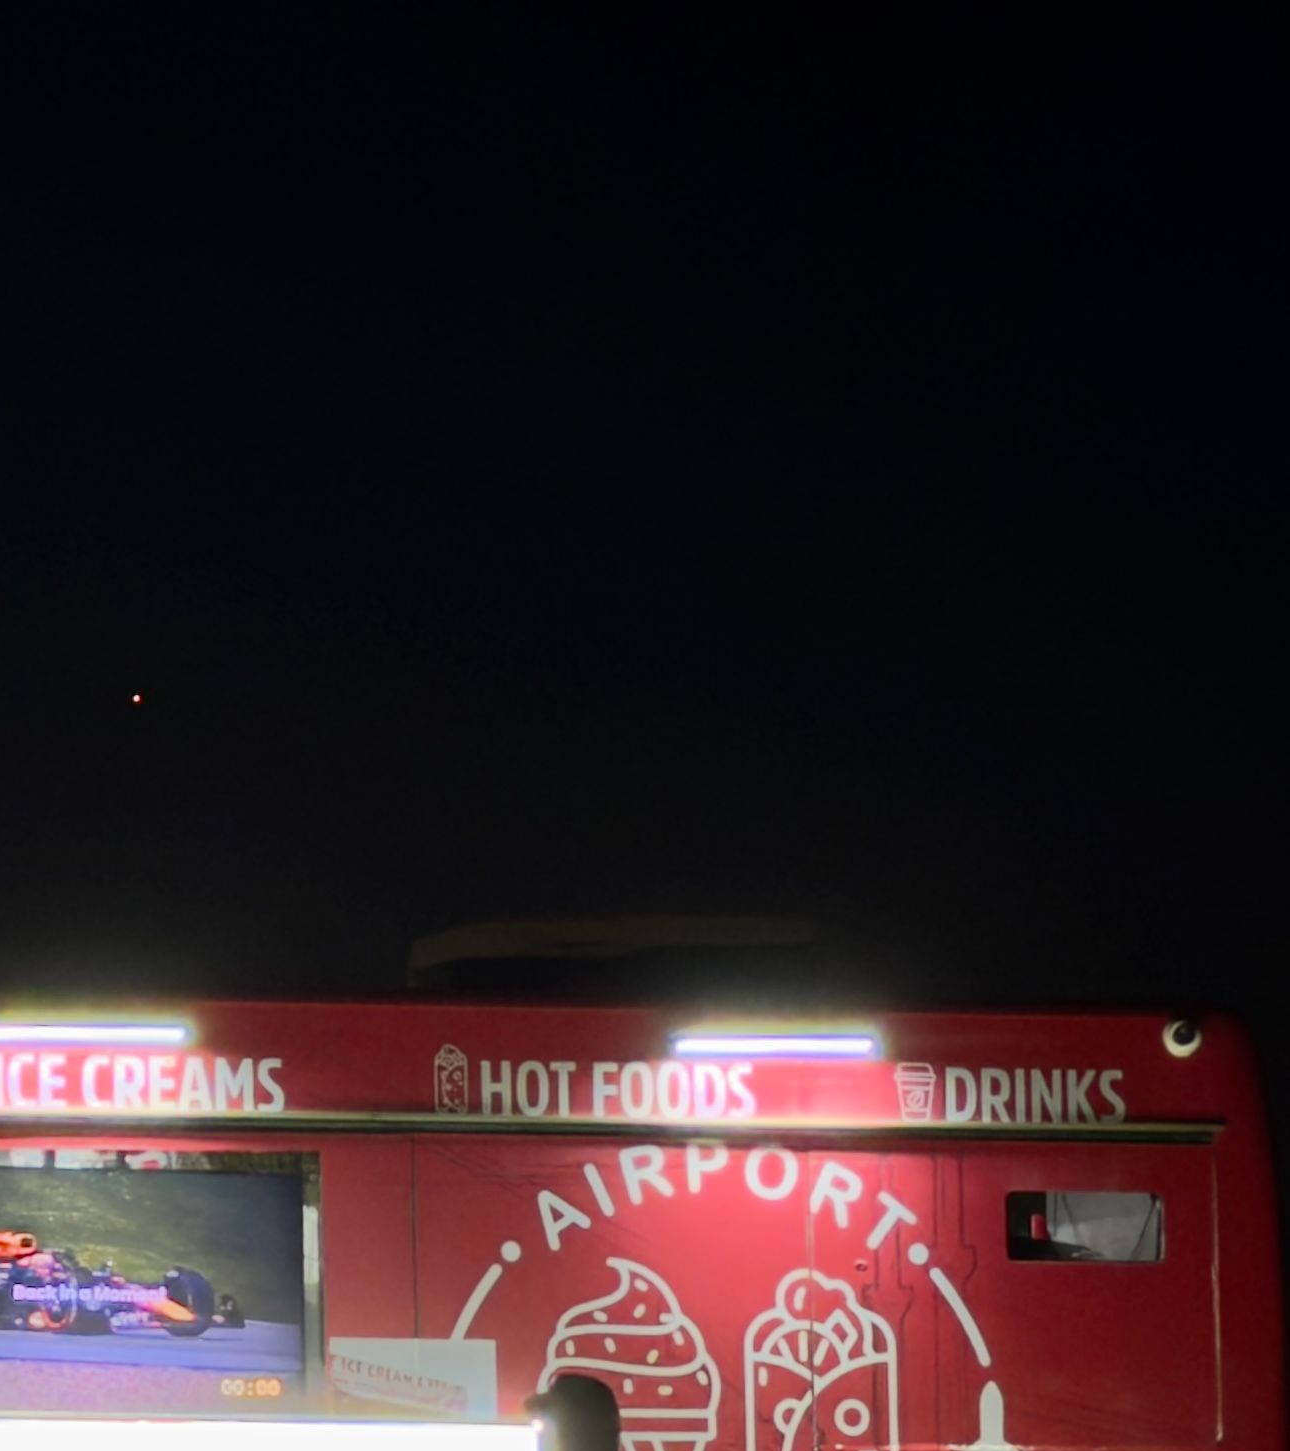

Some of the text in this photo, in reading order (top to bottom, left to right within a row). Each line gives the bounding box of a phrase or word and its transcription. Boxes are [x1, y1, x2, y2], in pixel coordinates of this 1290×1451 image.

[81, 1053, 286, 1113] CREAMS
[480, 1059, 757, 1119] HOT FOODS
[945, 1066, 1127, 1124] DRINKS
[536, 1144, 918, 1252] AIRPORT
